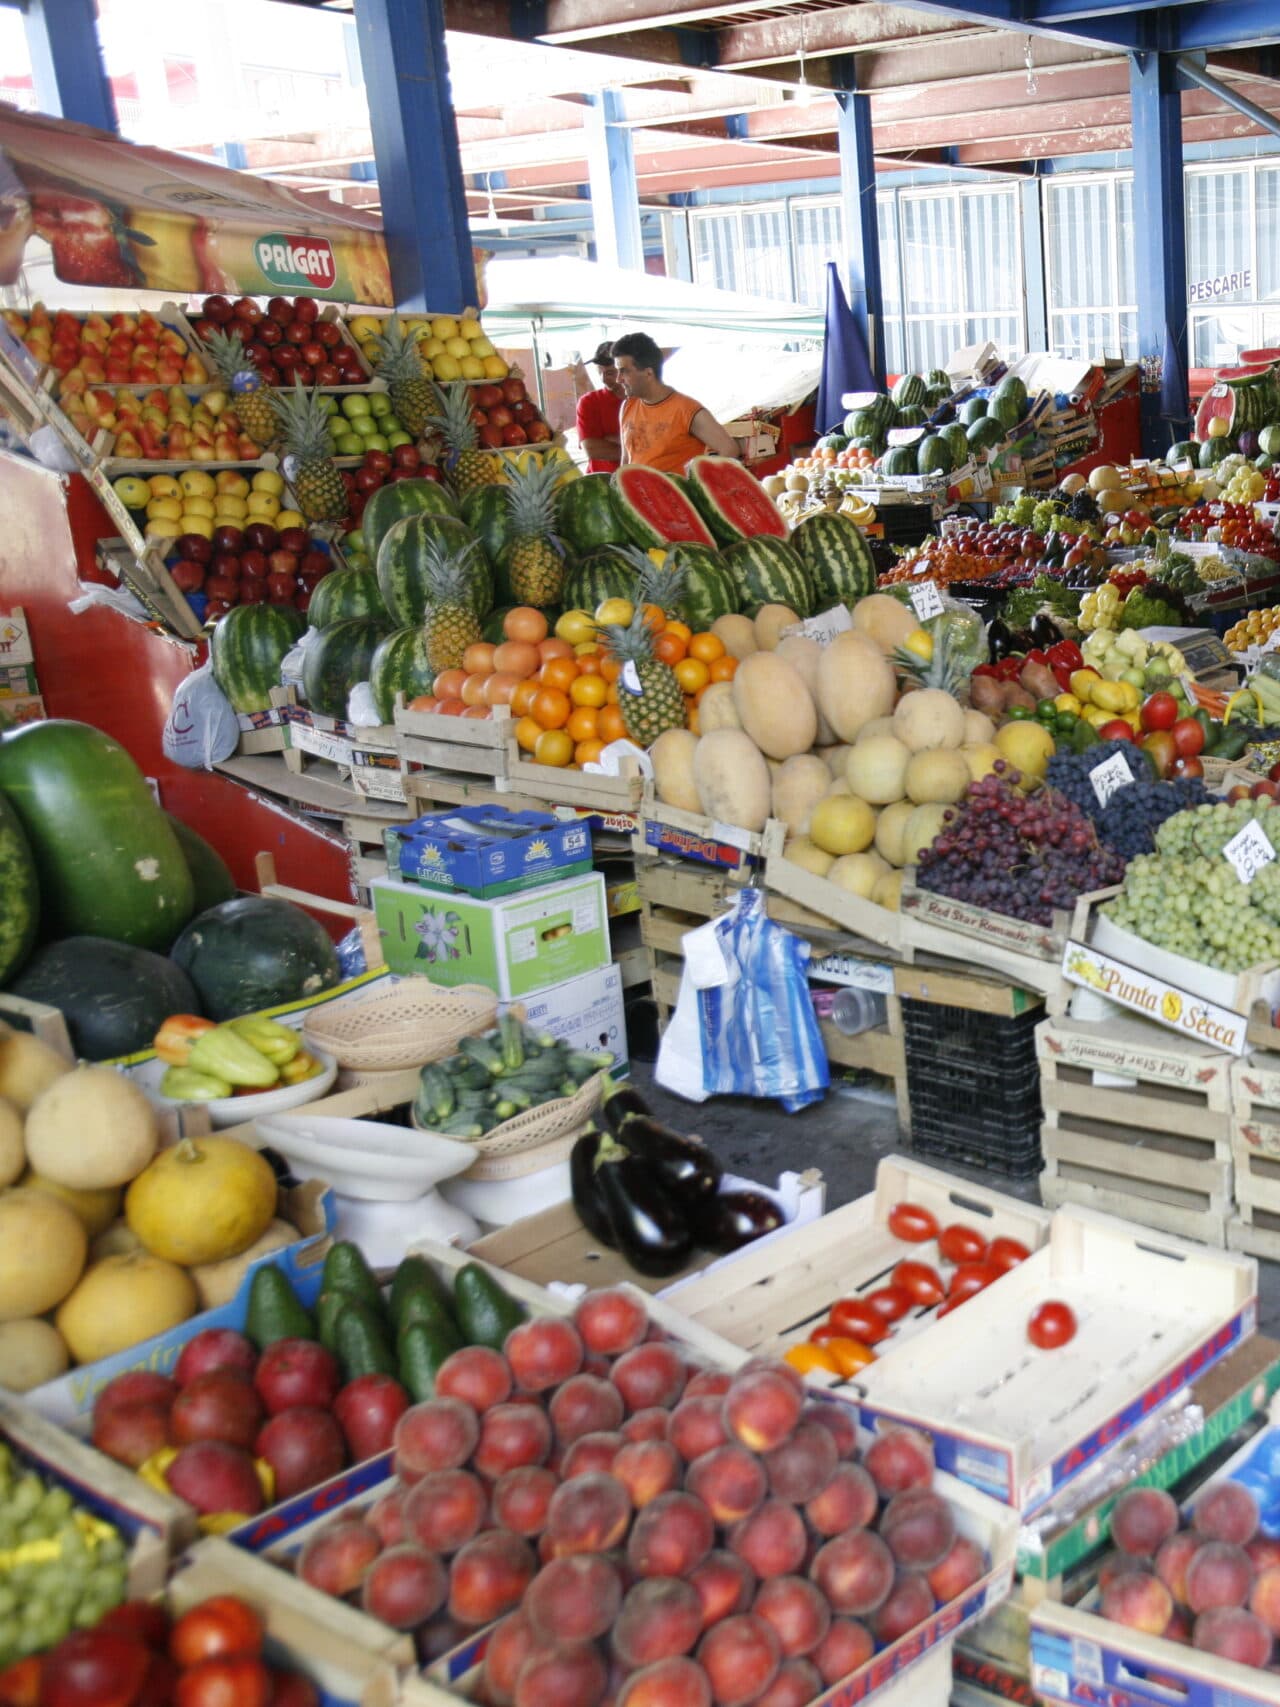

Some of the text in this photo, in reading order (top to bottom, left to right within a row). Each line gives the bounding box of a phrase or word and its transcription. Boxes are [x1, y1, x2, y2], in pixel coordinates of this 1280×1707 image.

[259, 242, 333, 277] PRIGAT
[1189, 269, 1251, 303] PESCARIE
[567, 835, 582, 848] 54
[416, 867, 454, 886] LIMES
[929, 902, 950, 919] Red
[951, 910, 977, 926] Star
[1099, 968, 1159, 1012] Punta
[1182, 1005, 1238, 1047] Secca
[1071, 1044, 1126, 1066] Romantic
[1128, 1056, 1157, 1072] Star
